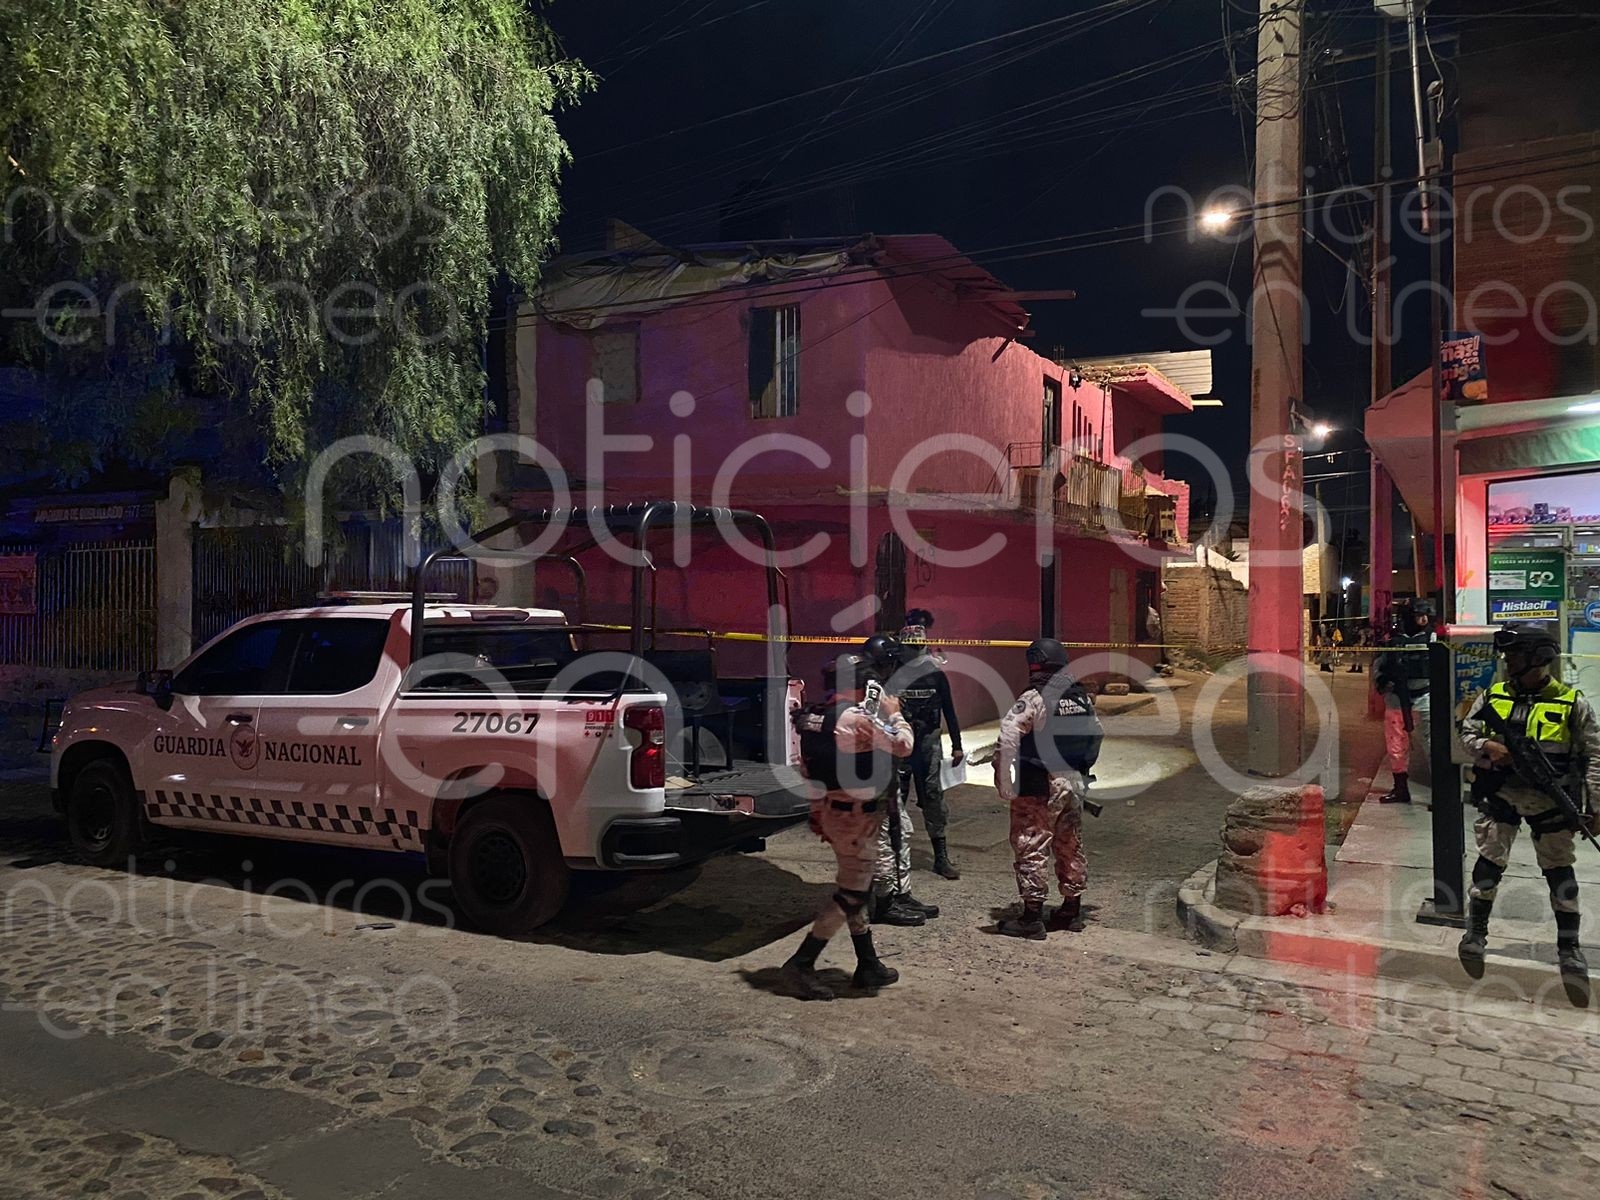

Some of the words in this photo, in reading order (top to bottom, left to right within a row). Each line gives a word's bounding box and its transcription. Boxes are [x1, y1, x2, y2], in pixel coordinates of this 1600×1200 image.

[1501, 600, 1552, 612] Histiacil
[452, 712, 541, 736] 27067
[587, 710, 614, 722] 911
[153, 734, 227, 758] GUARDIA
[265, 741, 362, 767] NACIONAL
